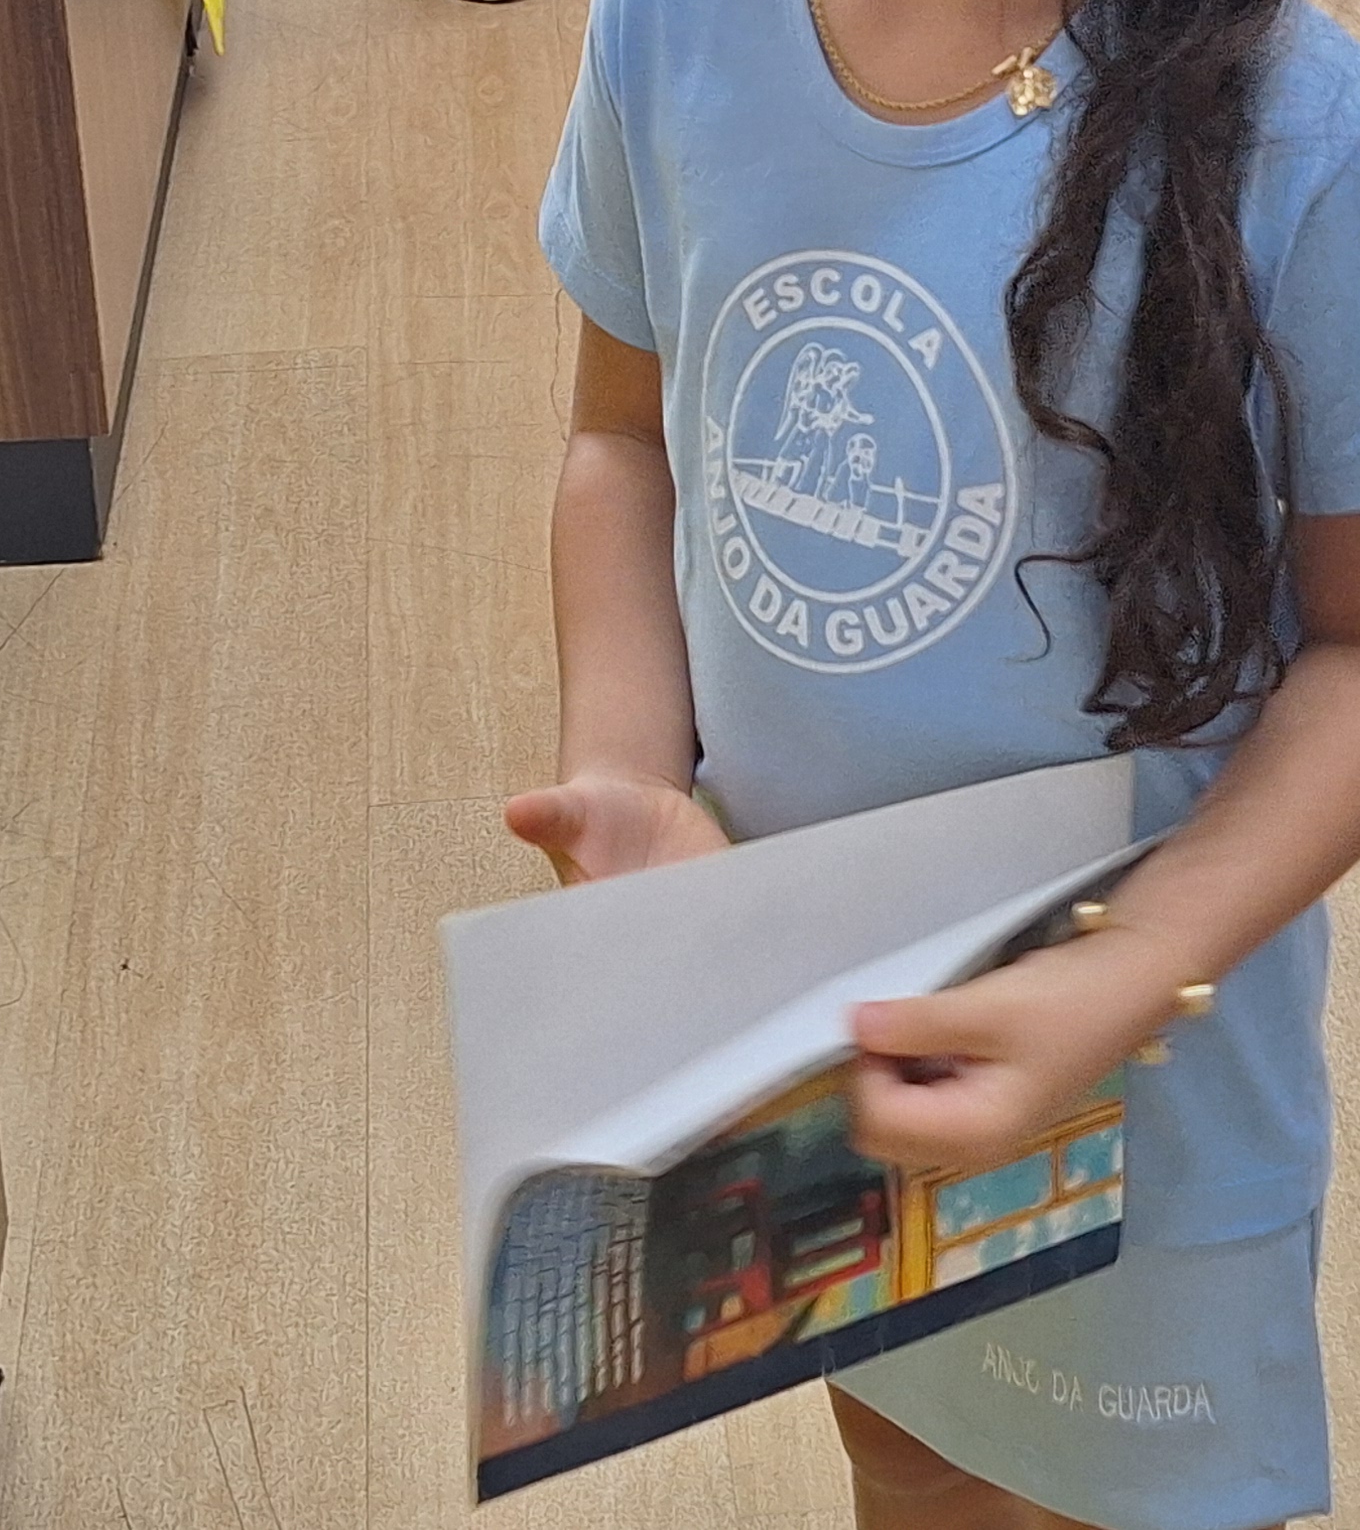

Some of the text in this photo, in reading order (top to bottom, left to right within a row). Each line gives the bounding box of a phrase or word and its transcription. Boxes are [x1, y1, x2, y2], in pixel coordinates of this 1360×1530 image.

[742, 266, 942, 371] ESCOLA
[749, 573, 809, 648] DA
[824, 472, 1006, 656] GUARDA
[1051, 1368, 1084, 1412] DA
[1097, 1381, 1217, 1426] GUARDA
